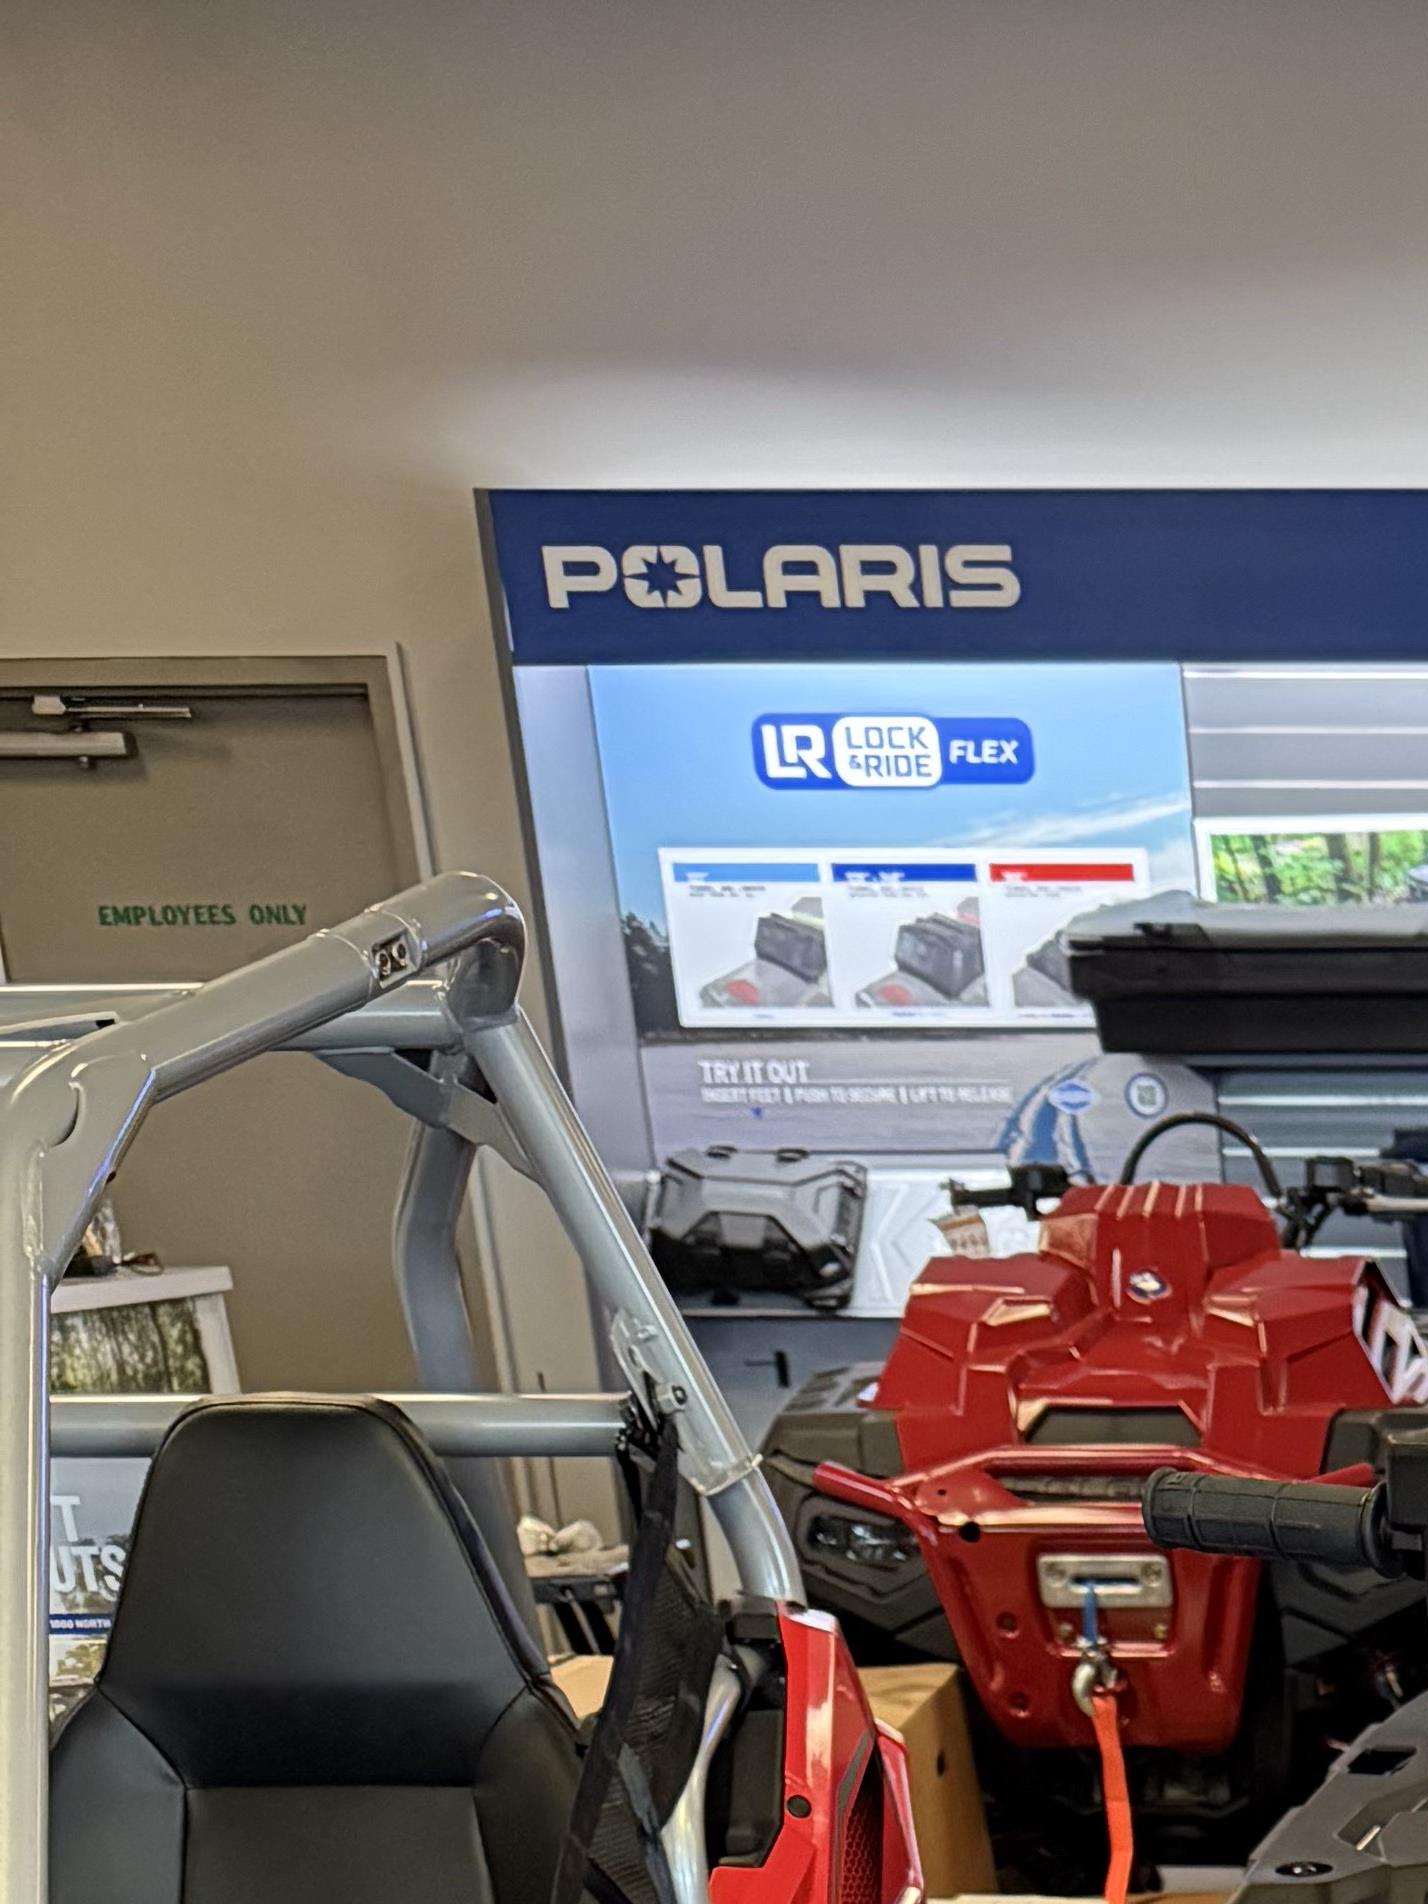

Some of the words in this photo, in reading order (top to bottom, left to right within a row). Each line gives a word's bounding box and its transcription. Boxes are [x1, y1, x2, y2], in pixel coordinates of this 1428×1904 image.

[541, 544, 1022, 609] POLARIS
[845, 726, 928, 750] LOCK
[949, 739, 1019, 765] FLEX
[98, 904, 236, 926] EMPLOYEES
[249, 904, 306, 925] ONLY
[697, 1059, 741, 1084] TRY
[742, 1059, 765, 1084] IT
[767, 1059, 810, 1084] OUT
[50, 1544, 127, 1602] UTS
